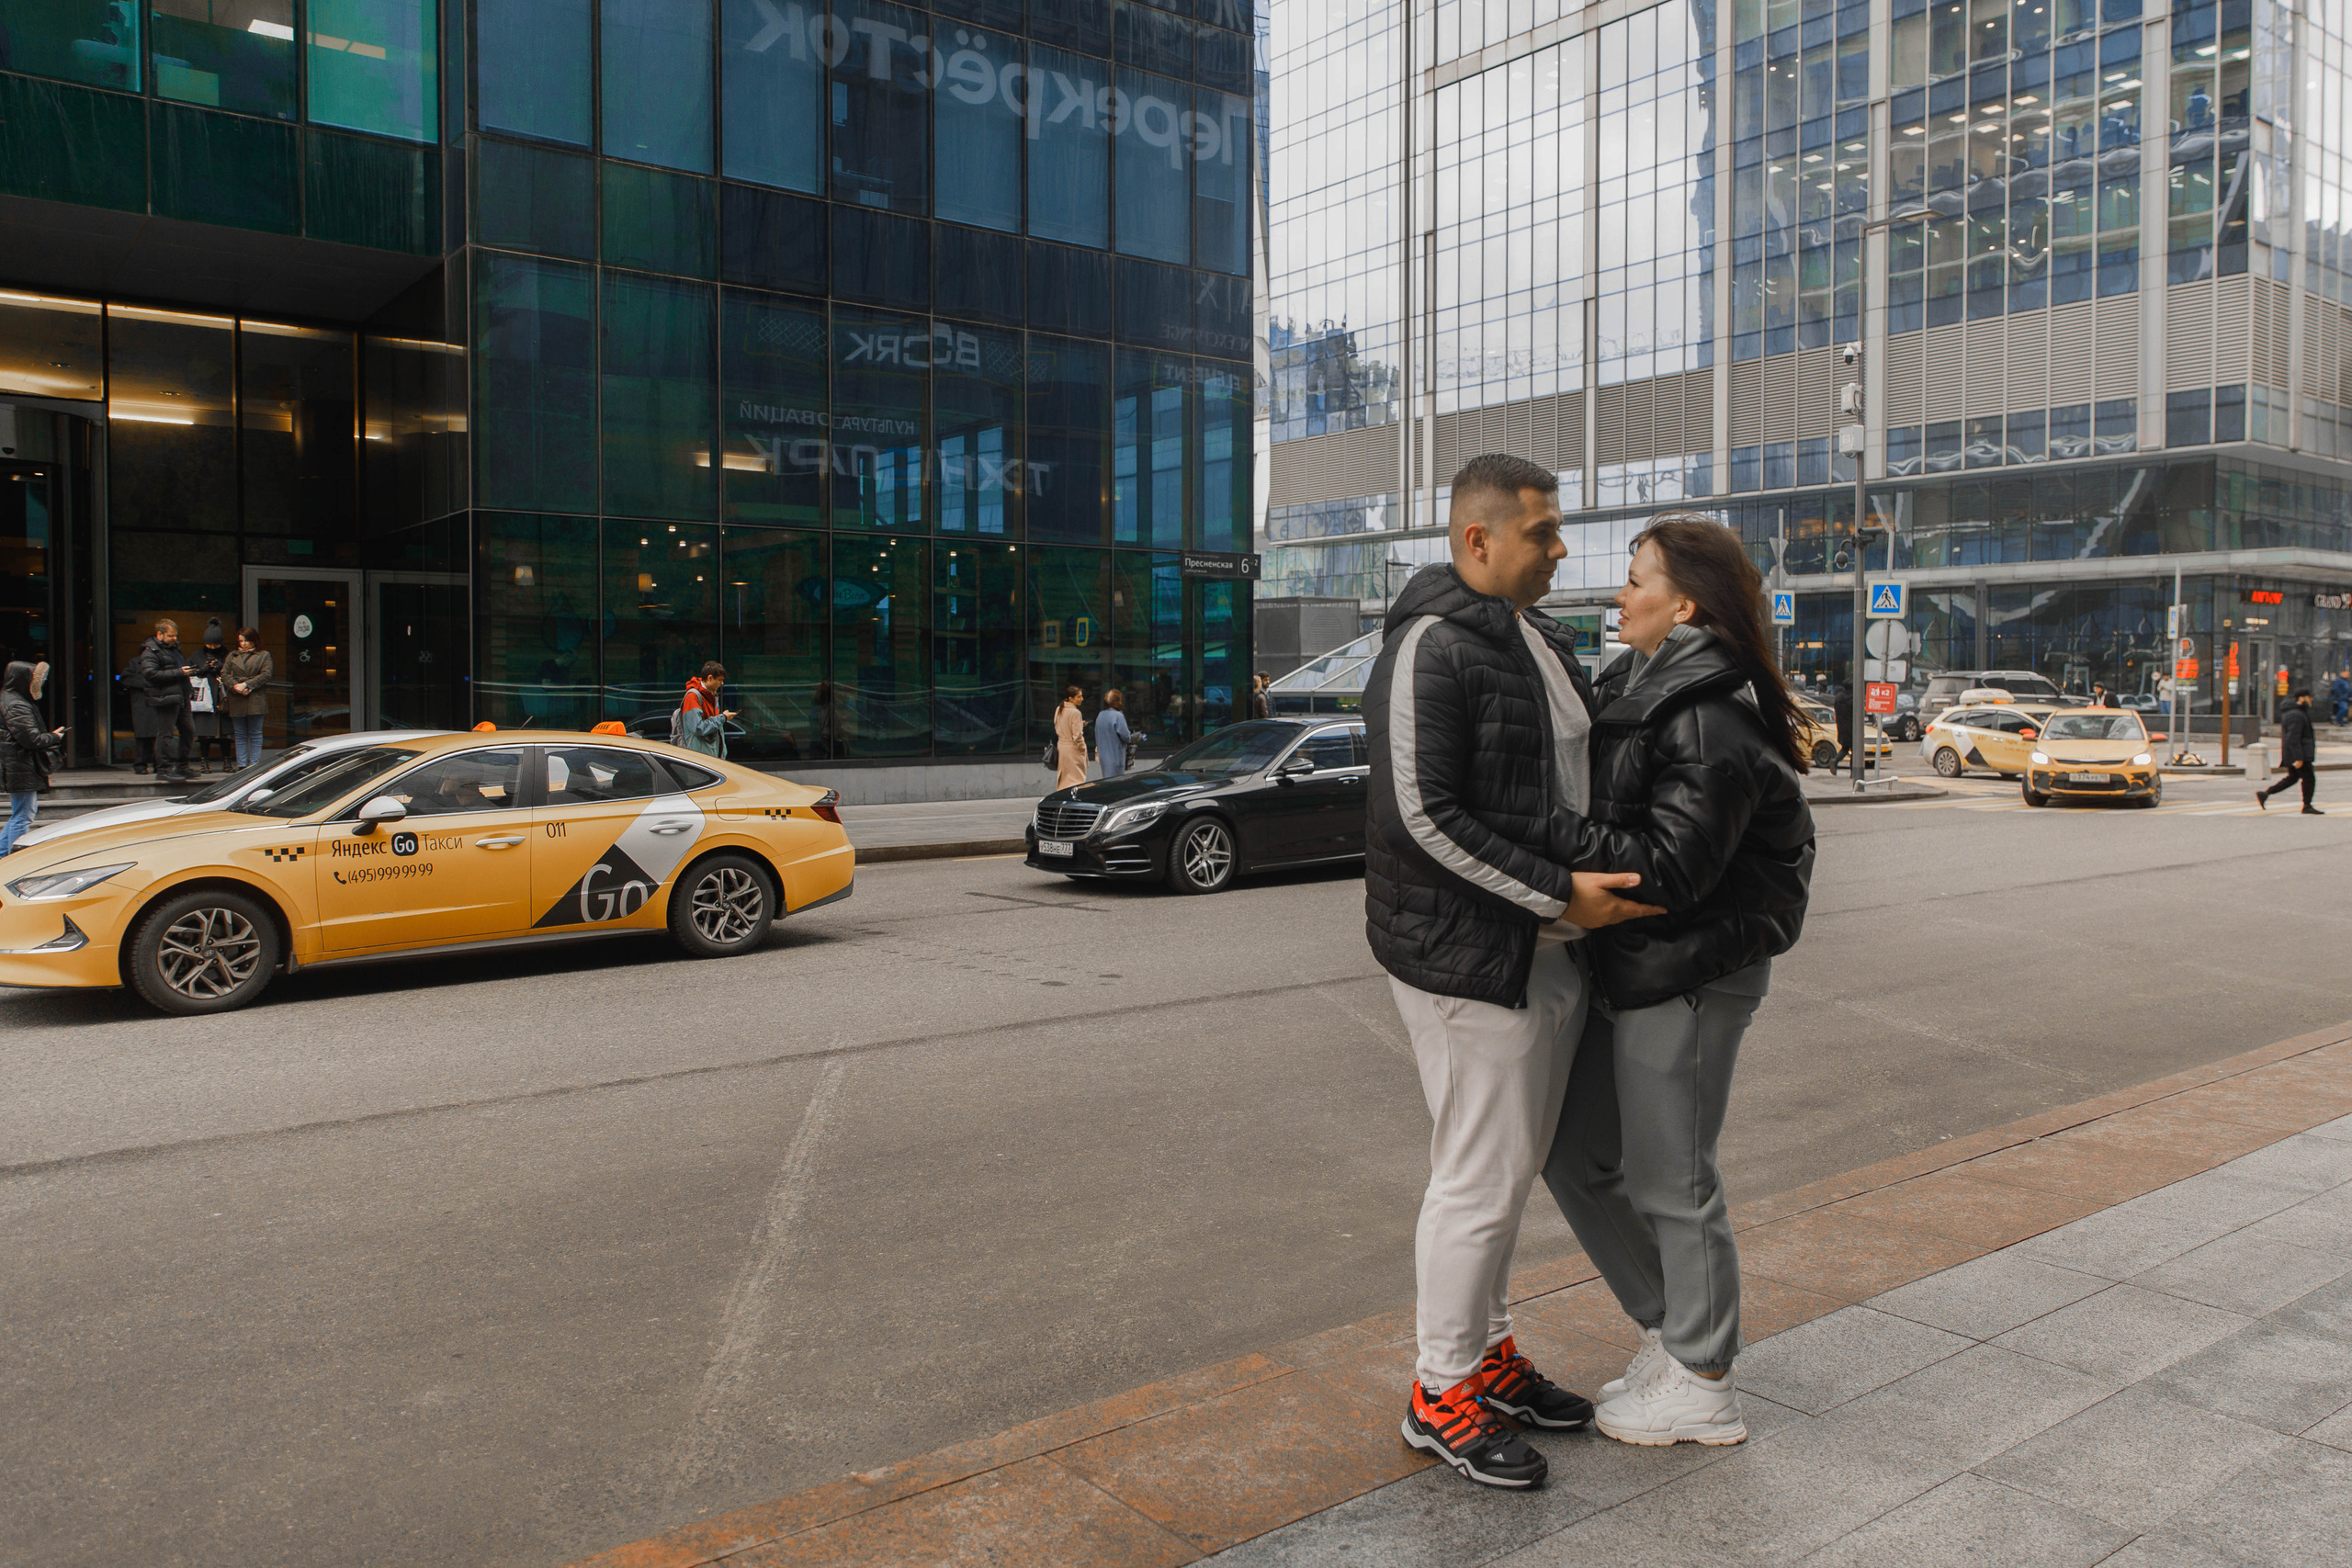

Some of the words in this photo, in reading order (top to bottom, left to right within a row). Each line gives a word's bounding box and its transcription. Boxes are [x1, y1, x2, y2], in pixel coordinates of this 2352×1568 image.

[1184, 558, 1233, 569] Пресненская
[1241, 558, 1249, 573] 6
[546, 822, 568, 839] 011
[332, 838, 388, 859] Яндекс
[394, 835, 415, 853] Go
[422, 834, 463, 852] Такси
[580, 863, 649, 923] Go
